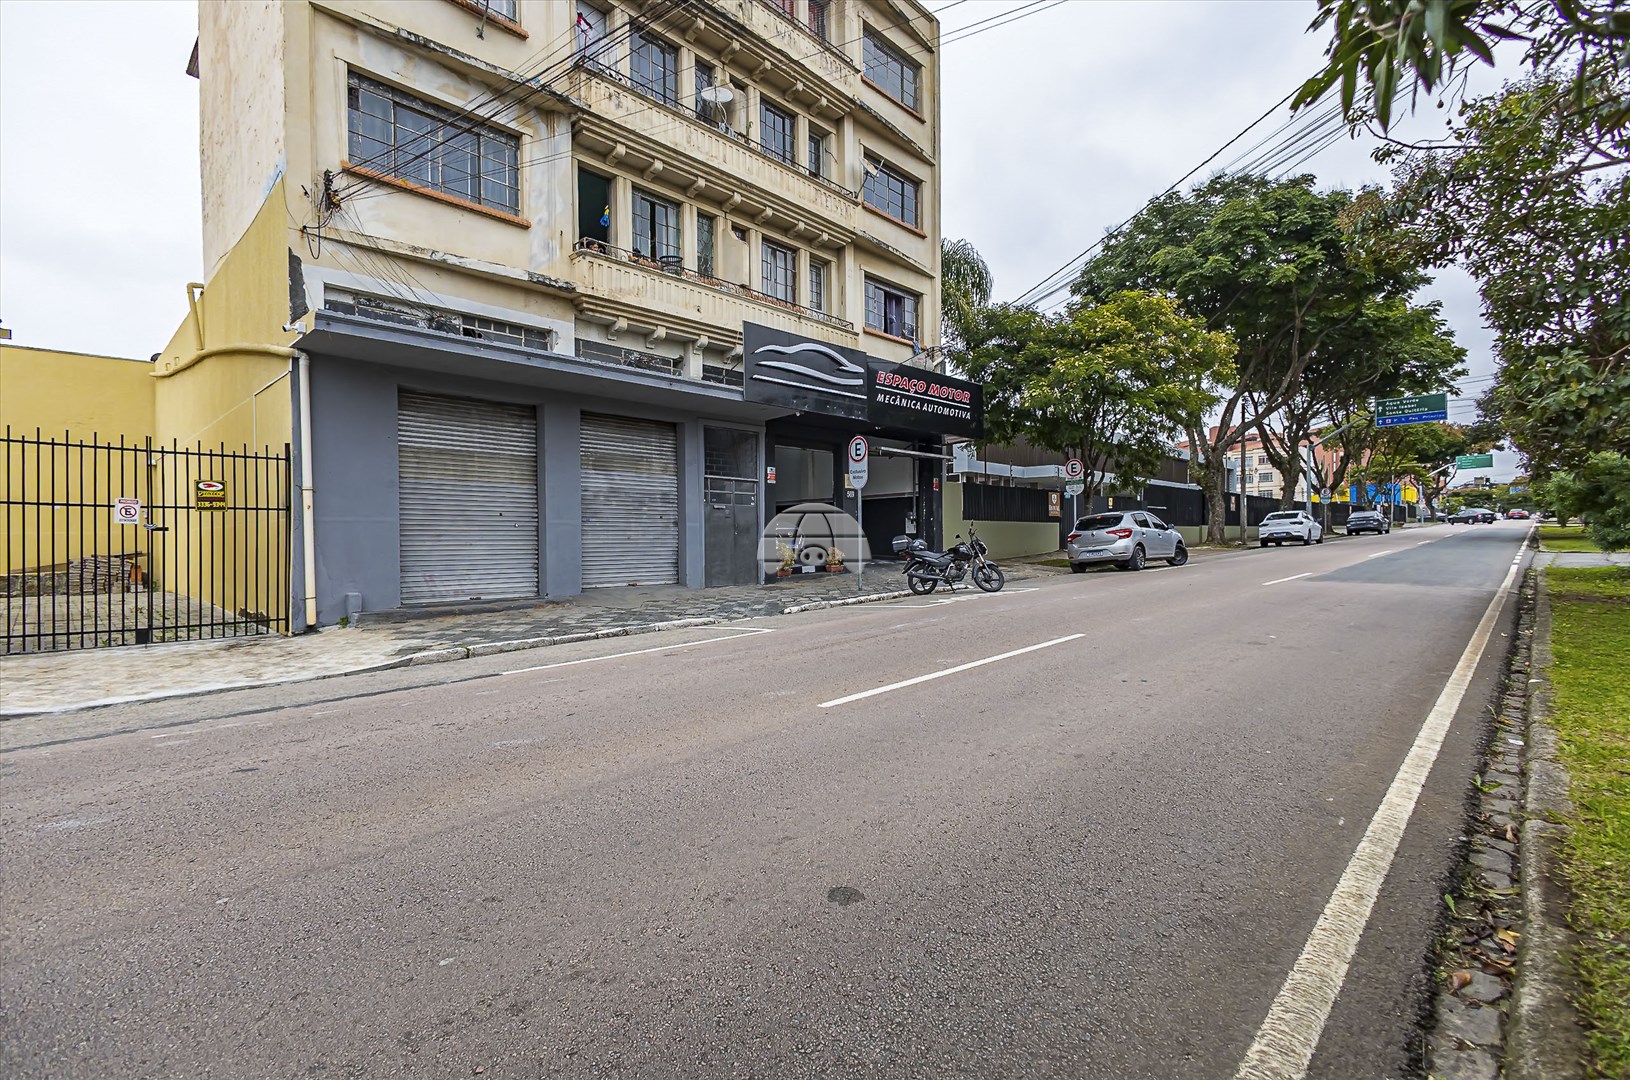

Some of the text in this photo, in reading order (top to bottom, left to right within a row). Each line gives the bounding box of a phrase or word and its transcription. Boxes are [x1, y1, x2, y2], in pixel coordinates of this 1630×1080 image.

[876, 371, 971, 403] ESPAÇO MOTOR
[876, 393, 971, 420] MECÂNICA AUTOMOTIVA
[854, 442, 862, 457] E
[1070, 463, 1077, 473] E
[125, 508, 133, 516] E
